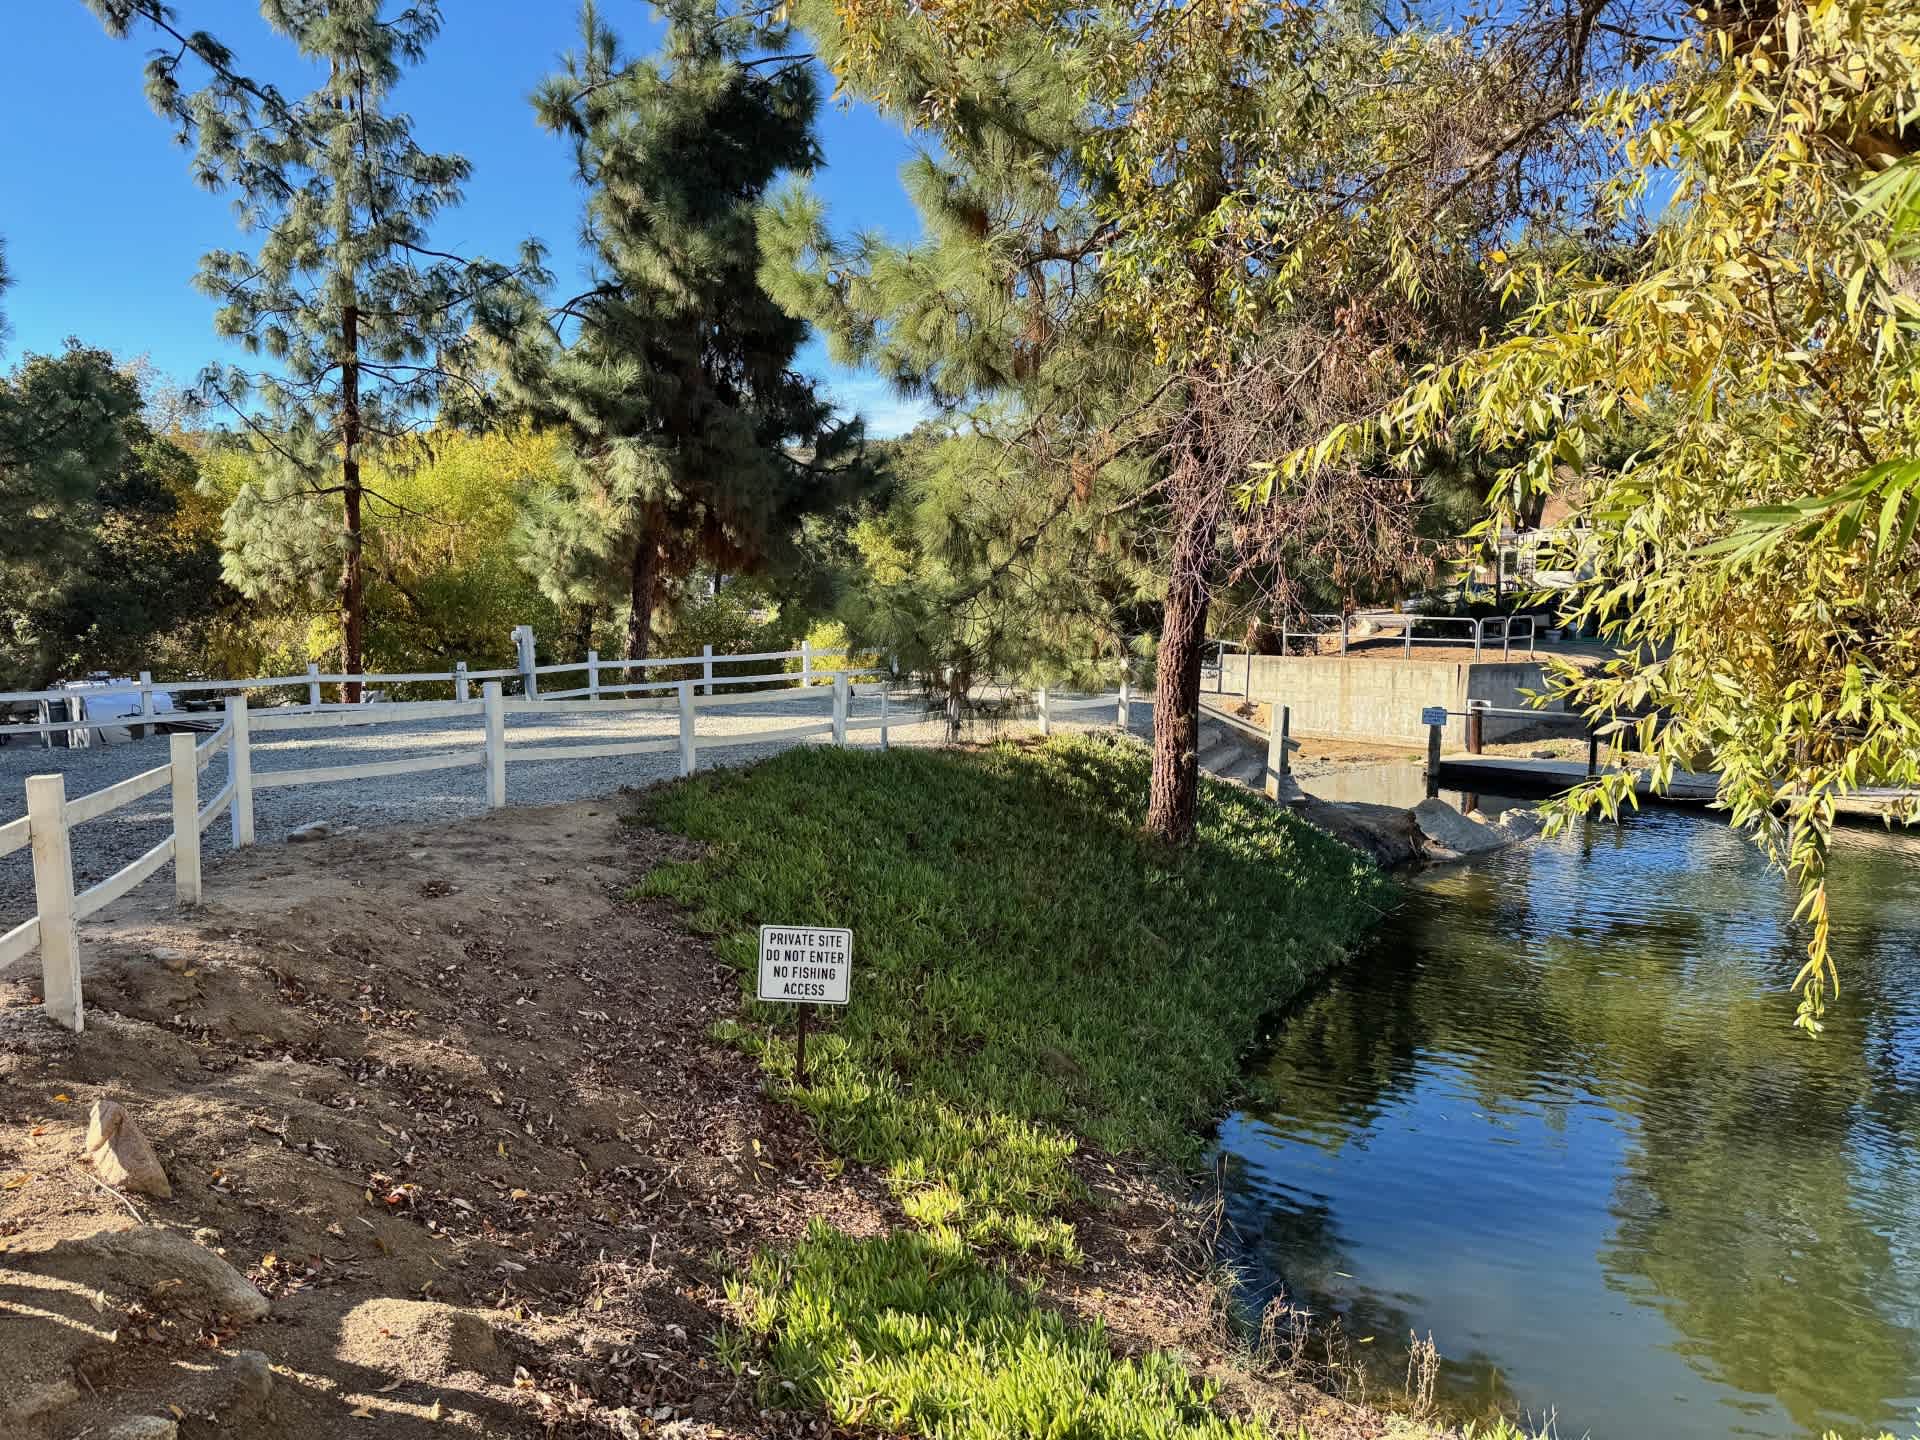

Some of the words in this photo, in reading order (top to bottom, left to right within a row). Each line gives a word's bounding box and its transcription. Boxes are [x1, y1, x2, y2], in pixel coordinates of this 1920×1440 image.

[770, 932, 815, 946] PRIVATE
[818, 935, 843, 948] SITE
[766, 949, 780, 961] DO
[784, 950, 806, 962] NOT
[809, 951, 844, 964] ENTER
[773, 965, 788, 978] NO
[792, 966, 836, 980] FISHING
[783, 983, 825, 997] ACCESS
